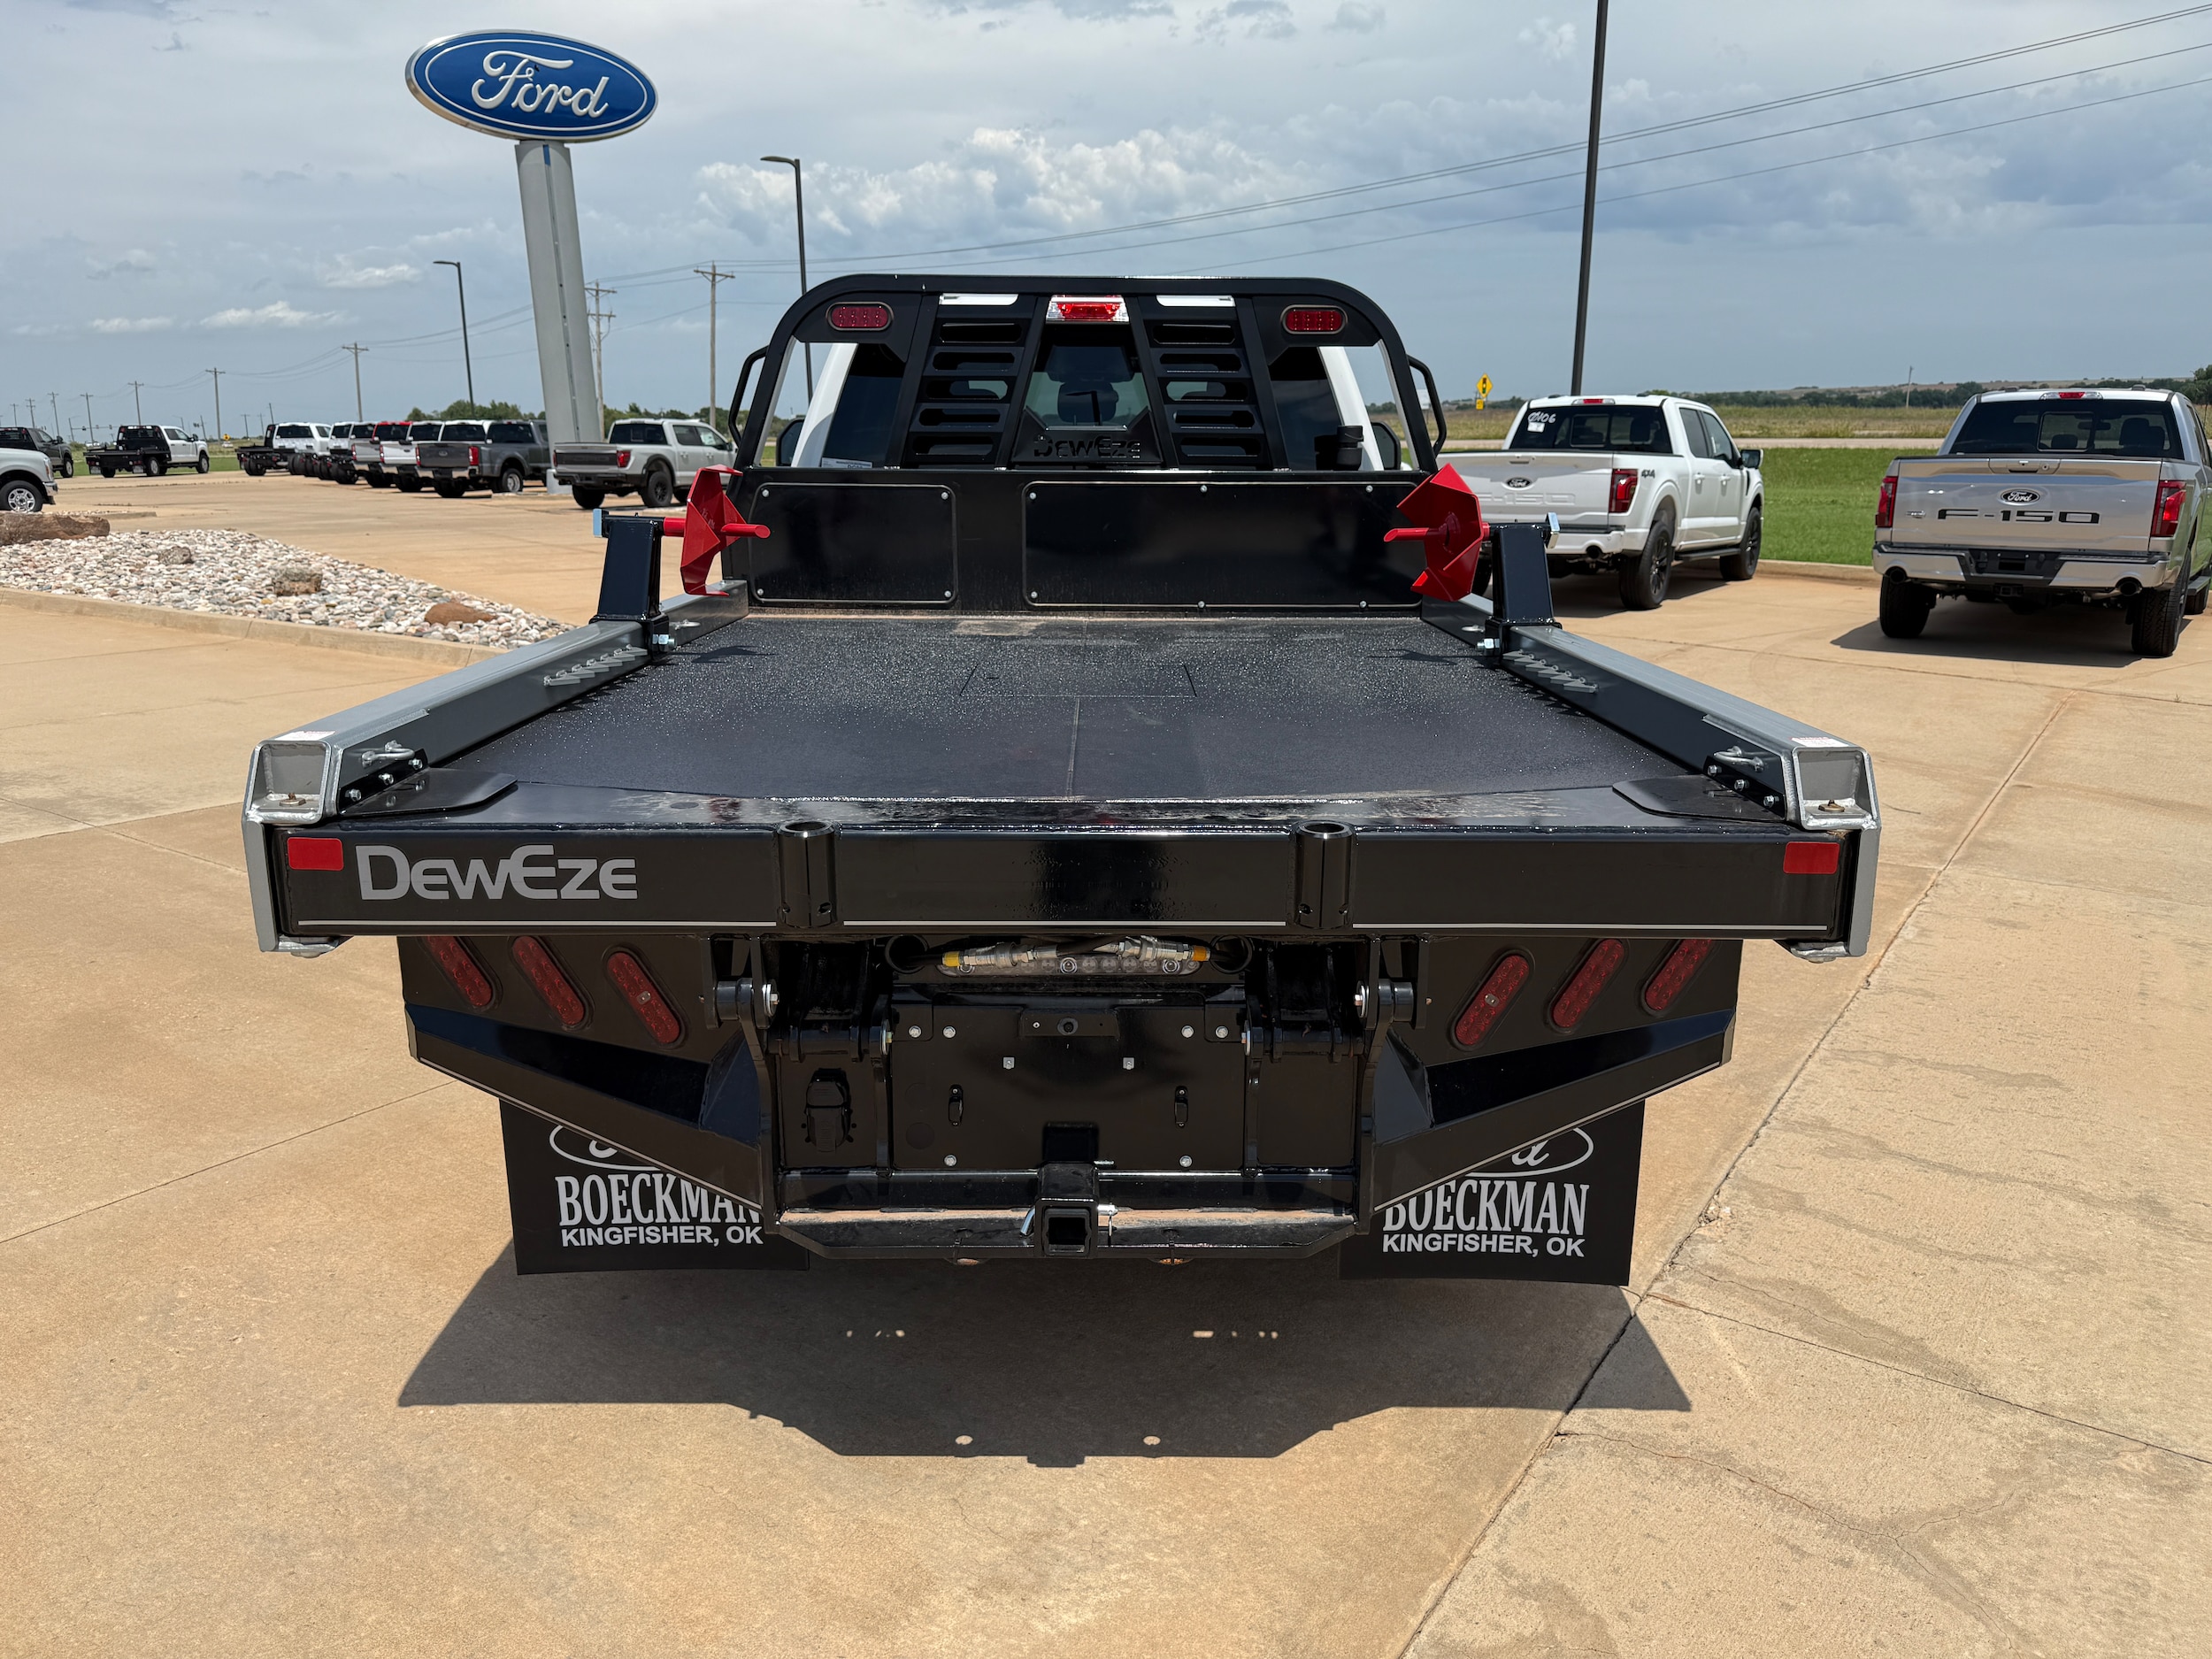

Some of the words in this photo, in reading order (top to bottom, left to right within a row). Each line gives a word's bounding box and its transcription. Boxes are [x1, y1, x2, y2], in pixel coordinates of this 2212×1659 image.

[471, 50, 610, 118] Ford
[1508, 478, 1531, 488] Ford
[2007, 491, 2033, 503] Ford
[1937, 509, 2100, 525] F-150
[561, 1226, 719, 1248] KINGFISHER,
[726, 1226, 764, 1245] OK
[1382, 1234, 1539, 1258] KINGFISHER,
[1547, 1237, 1586, 1257] OK
